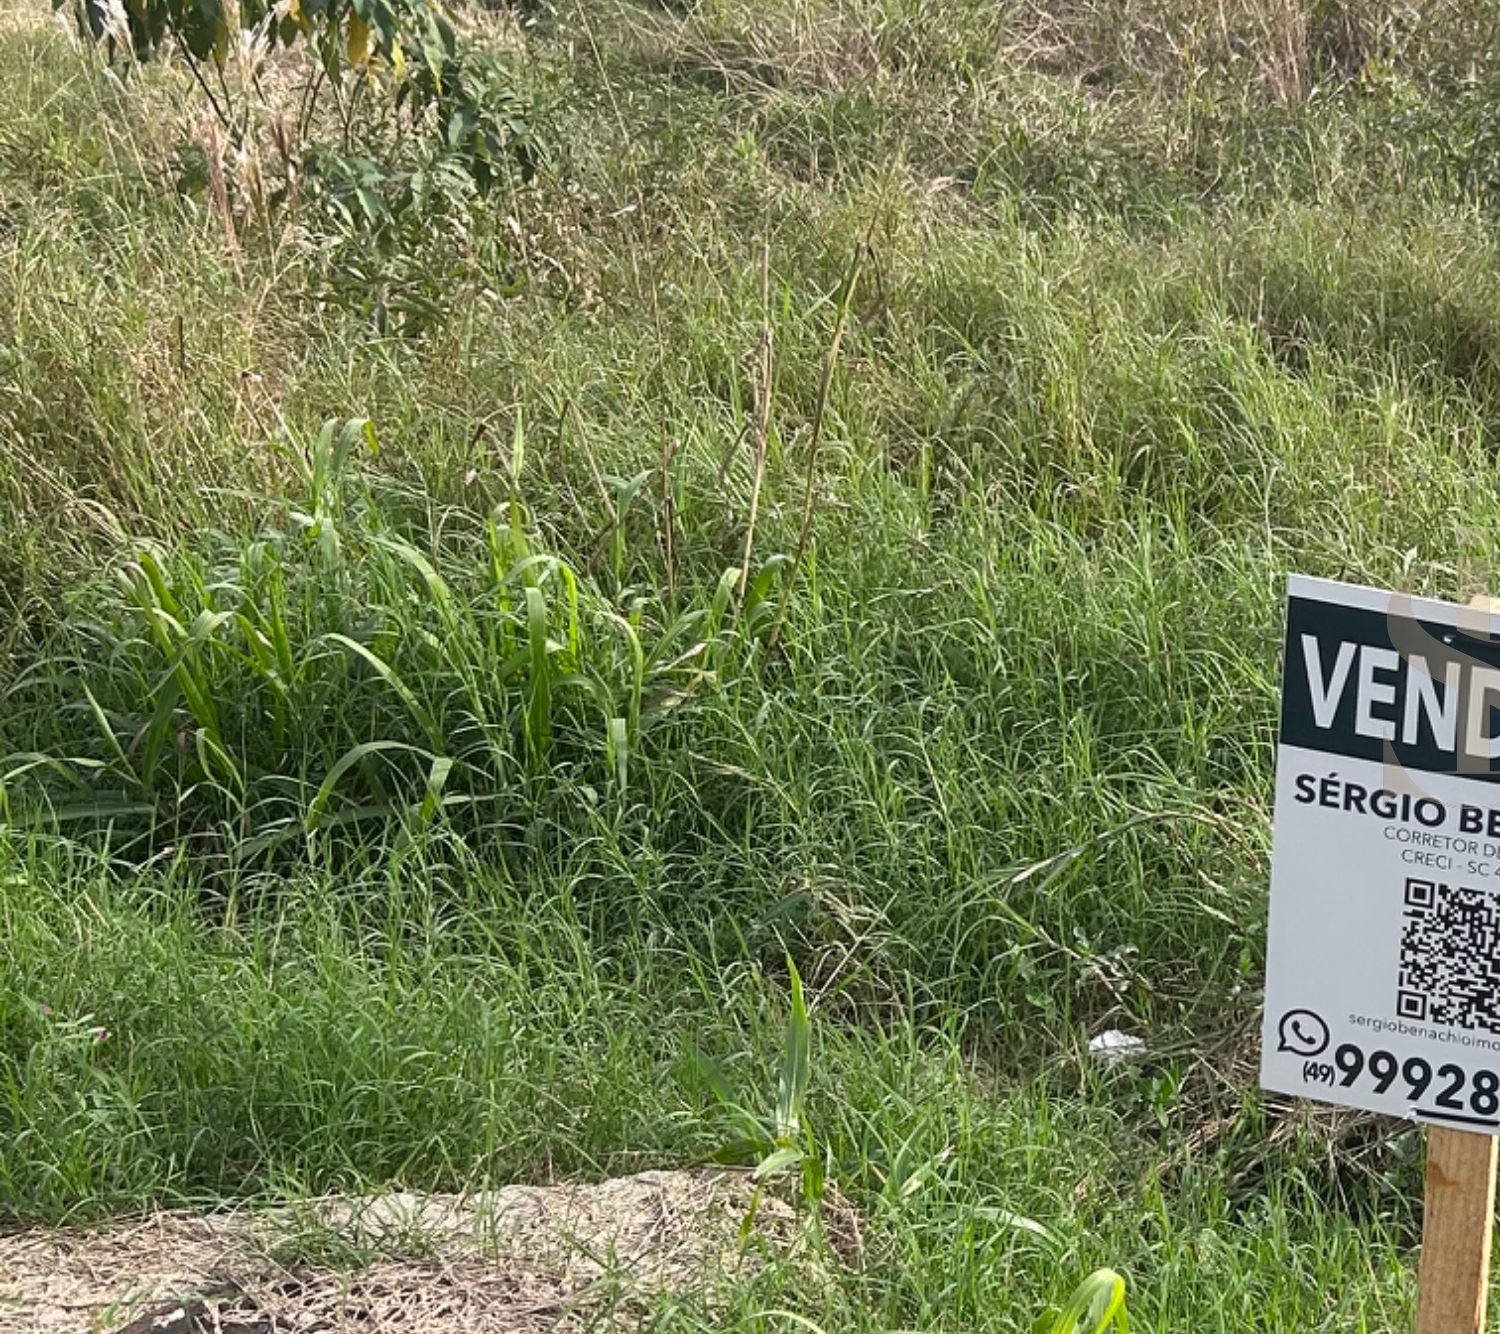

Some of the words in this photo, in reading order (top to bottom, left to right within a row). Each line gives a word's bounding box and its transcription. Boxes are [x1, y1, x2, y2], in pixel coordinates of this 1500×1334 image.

[1294, 772, 1447, 828] SÉRGIO
[1384, 826, 1478, 854] CORRETOR
[1401, 849, 1453, 870] CRECI
[1468, 861, 1491, 877] SC
